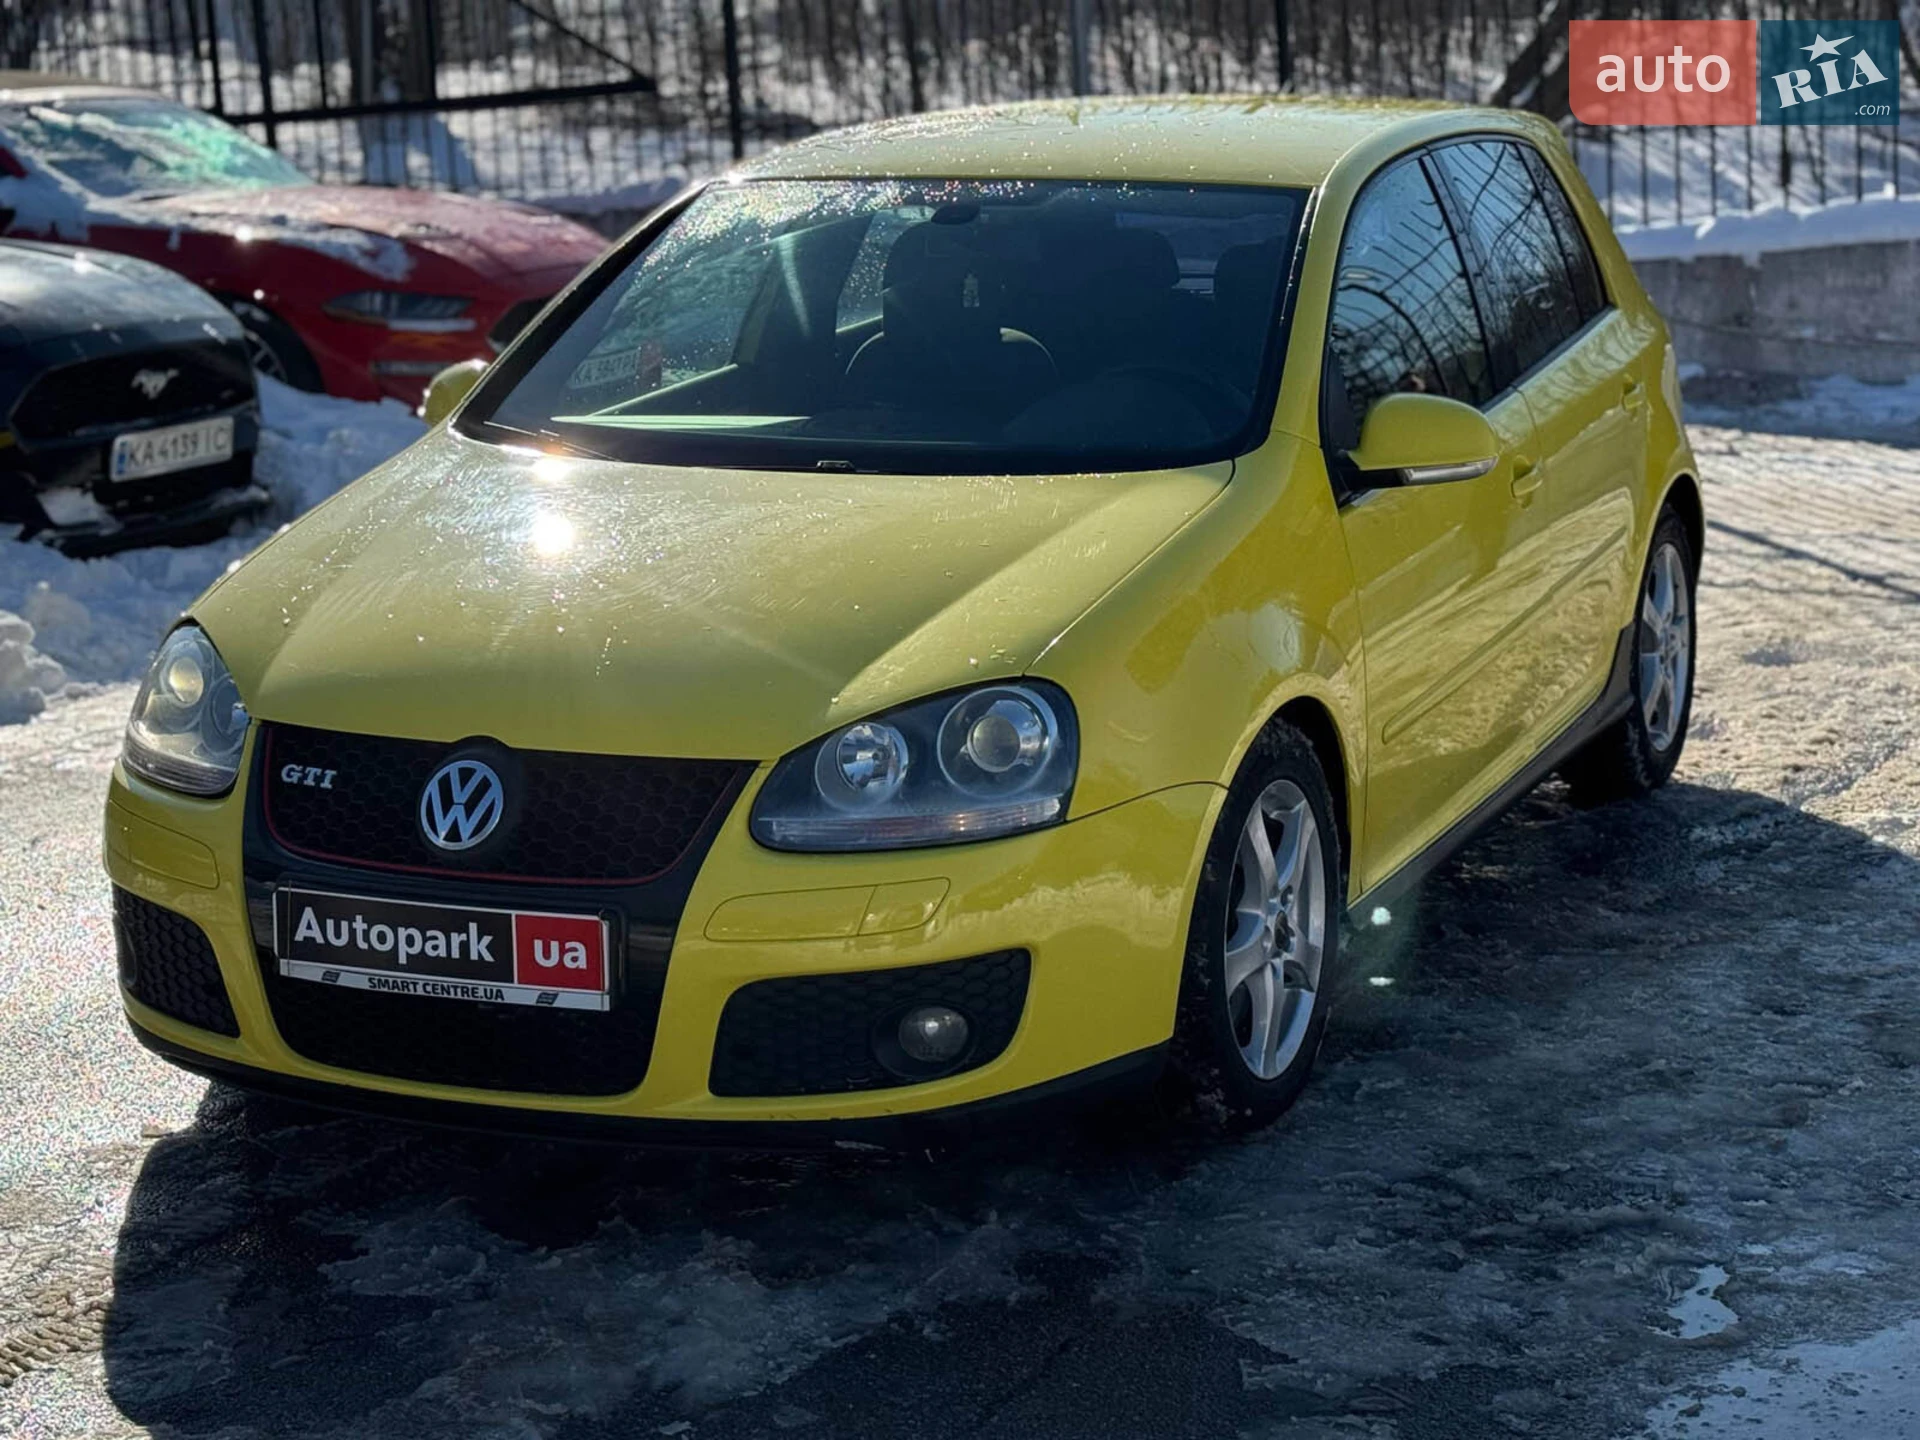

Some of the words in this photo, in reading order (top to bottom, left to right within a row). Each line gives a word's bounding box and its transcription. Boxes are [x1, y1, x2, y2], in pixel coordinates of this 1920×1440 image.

[128, 441, 154, 466] KA
[205, 426, 229, 452] IC
[281, 764, 337, 788] GTI
[294, 906, 495, 964] Autopark
[533, 940, 587, 969] ua
[368, 977, 419, 994] SMART
[422, 982, 505, 1001] CENTRE.UA
